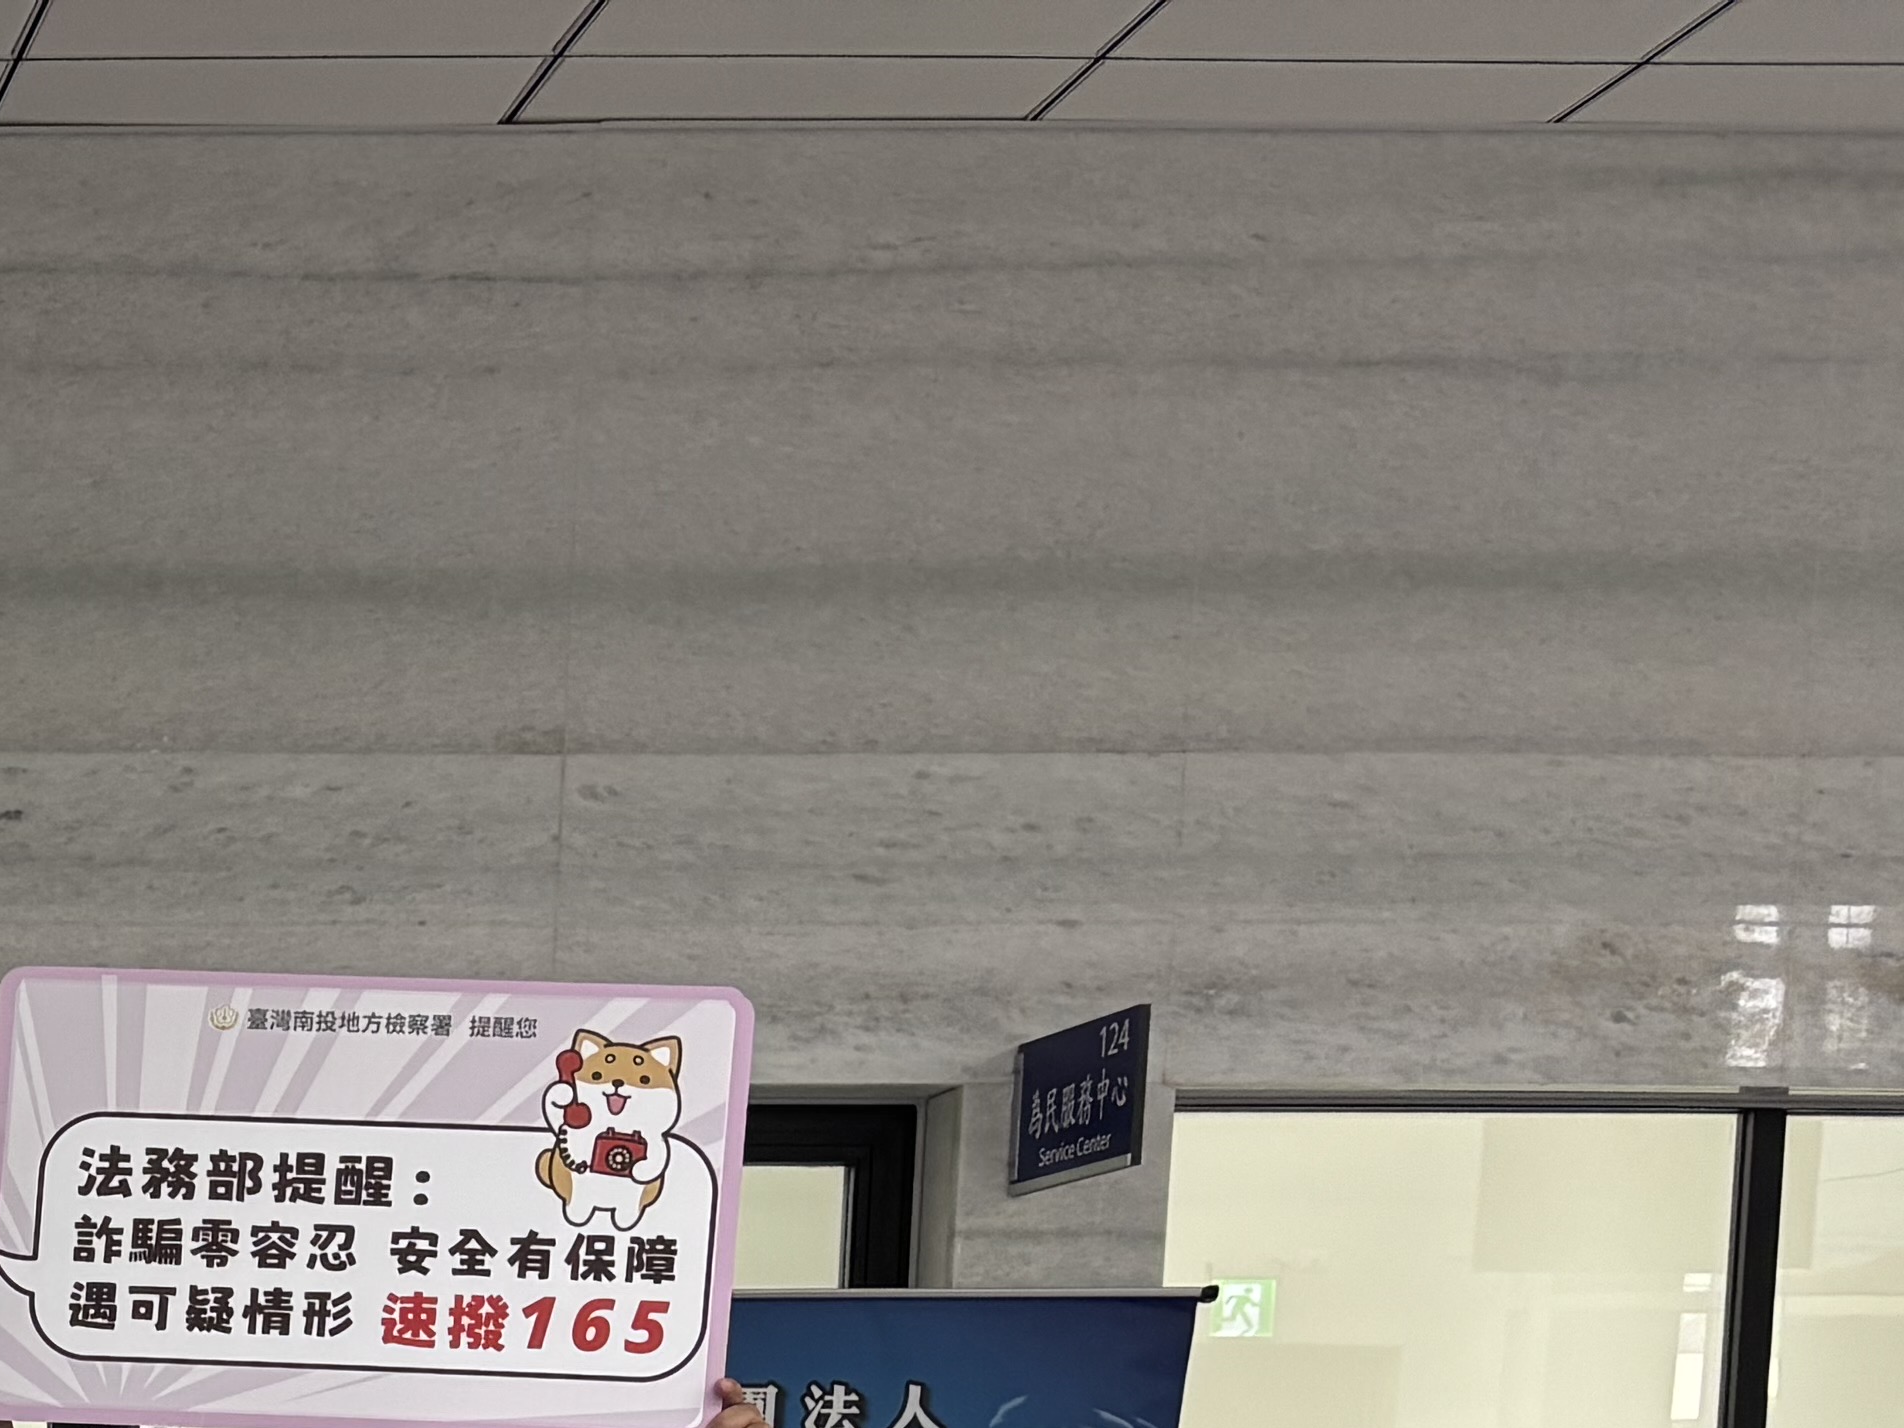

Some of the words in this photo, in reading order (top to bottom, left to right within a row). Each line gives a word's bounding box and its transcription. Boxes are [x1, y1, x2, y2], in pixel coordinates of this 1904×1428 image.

[246, 1007, 453, 1038] 臺灣南投地方檢察署
[468, 1014, 538, 1041] 提醒您
[1099, 1018, 1130, 1058] 124
[1028, 1068, 1129, 1140] 為民服務中心
[77, 1145, 432, 1208] 法務部提醒：
[1038, 1141, 1075, 1167] Service
[1076, 1133, 1112, 1157] Center
[71, 1213, 358, 1271] 詐騙零容忍
[390, 1226, 679, 1286] 安全有保障
[67, 1281, 355, 1339] 遇可疑情形
[380, 1291, 671, 1354] 速撥165
